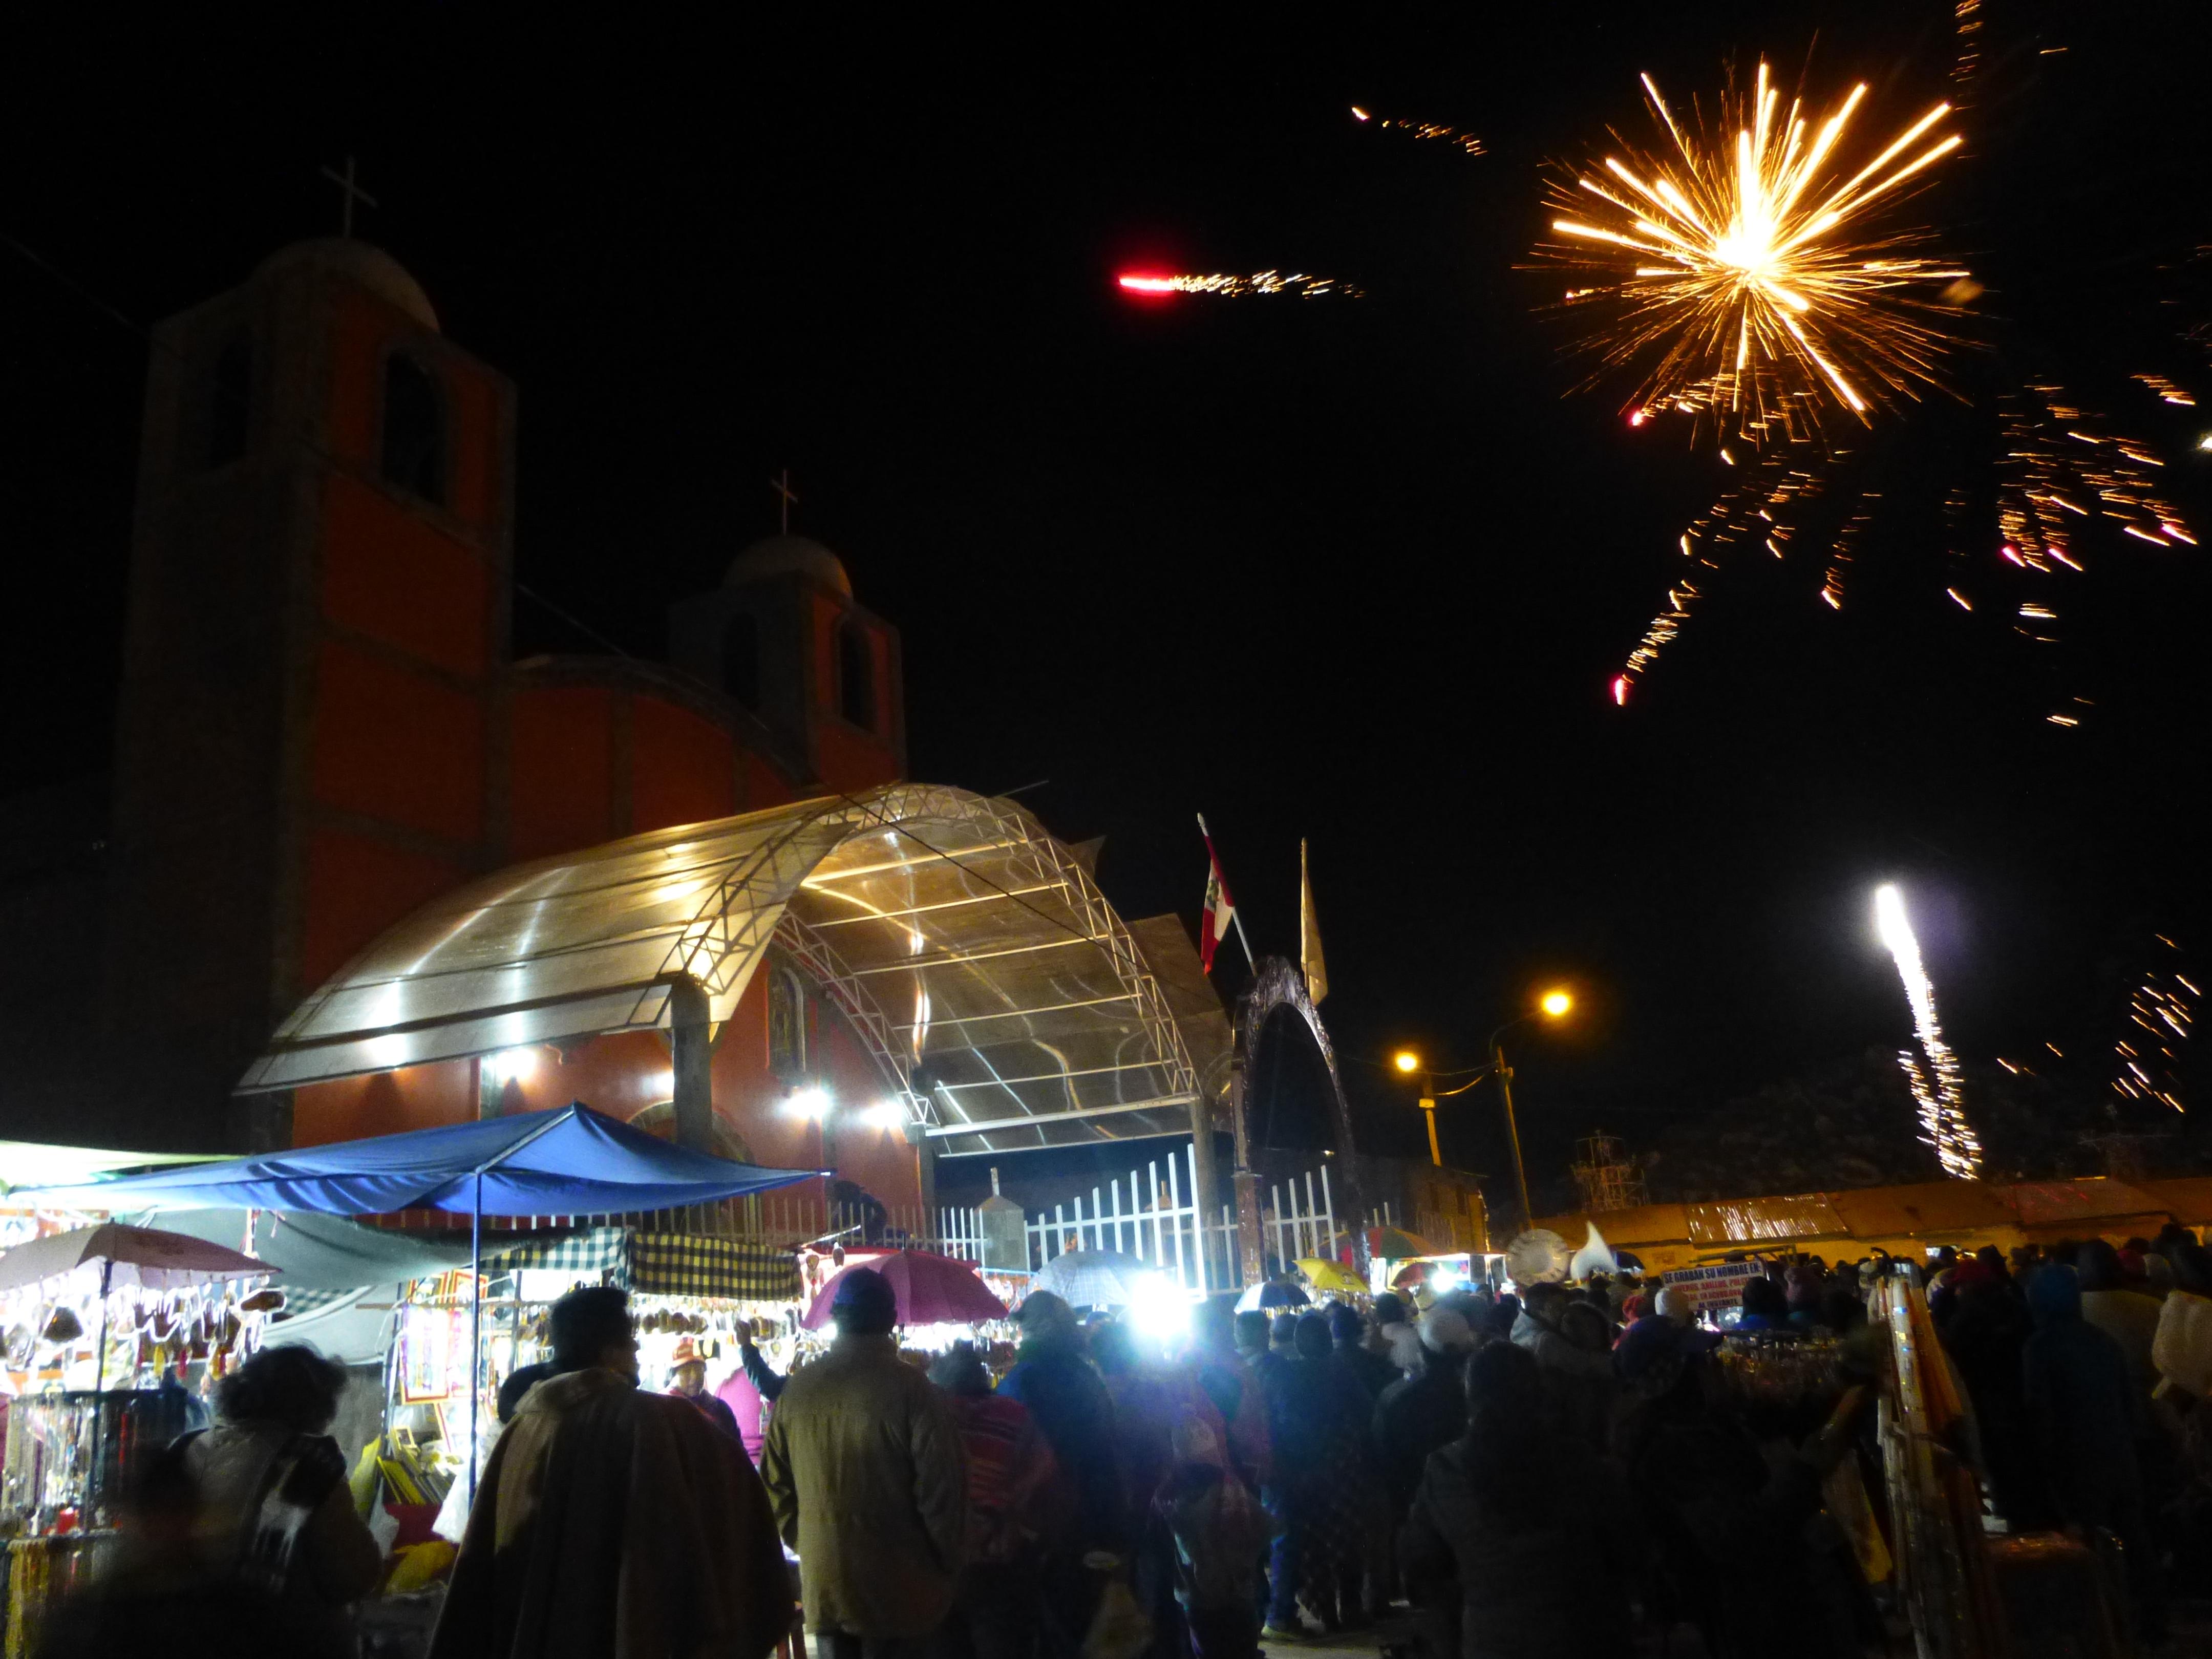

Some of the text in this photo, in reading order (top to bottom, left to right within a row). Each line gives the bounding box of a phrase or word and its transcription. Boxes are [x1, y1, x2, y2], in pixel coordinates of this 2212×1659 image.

[1664, 1273, 1673, 1283] SE
[1674, 1270, 1704, 1282] GRABAN
[1705, 1268, 1715, 1279] SU
[1717, 1264, 1748, 1277] NOMBRE
